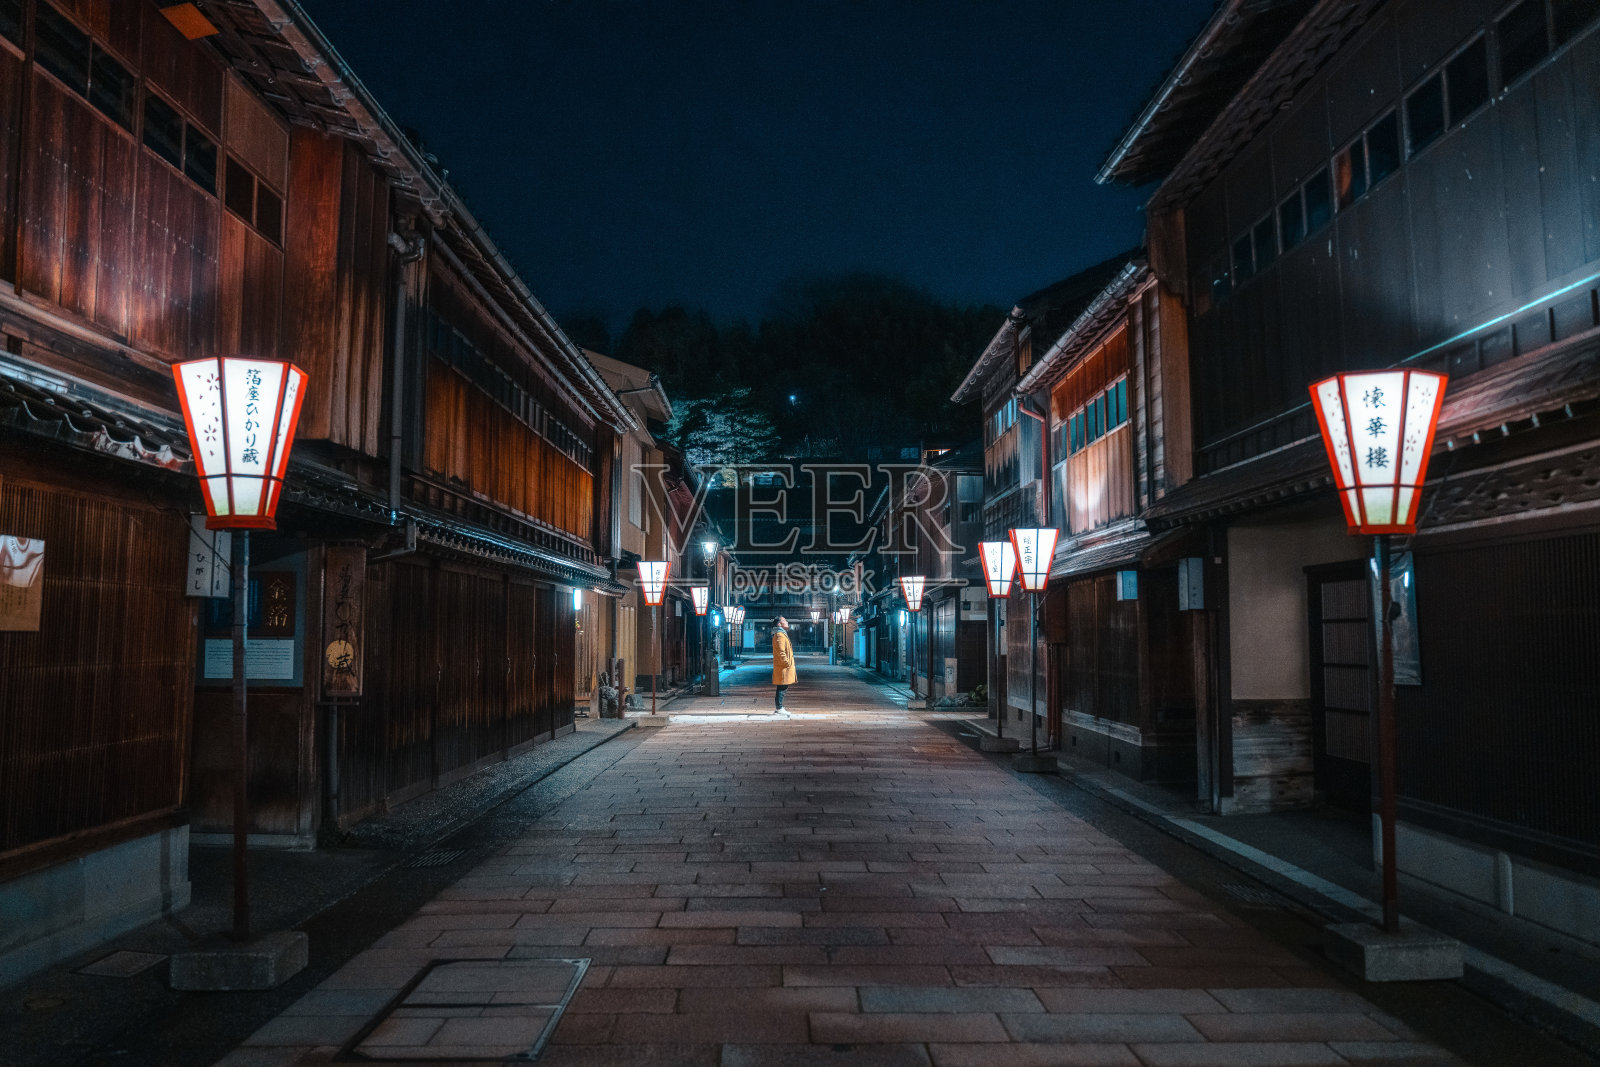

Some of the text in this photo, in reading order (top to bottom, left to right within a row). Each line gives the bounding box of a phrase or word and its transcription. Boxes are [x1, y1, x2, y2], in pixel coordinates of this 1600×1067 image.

[242, 368, 262, 465] 箔座ひかり蔵
[194, 552, 206, 591] ひがし
[267, 578, 290, 628] 金箔
